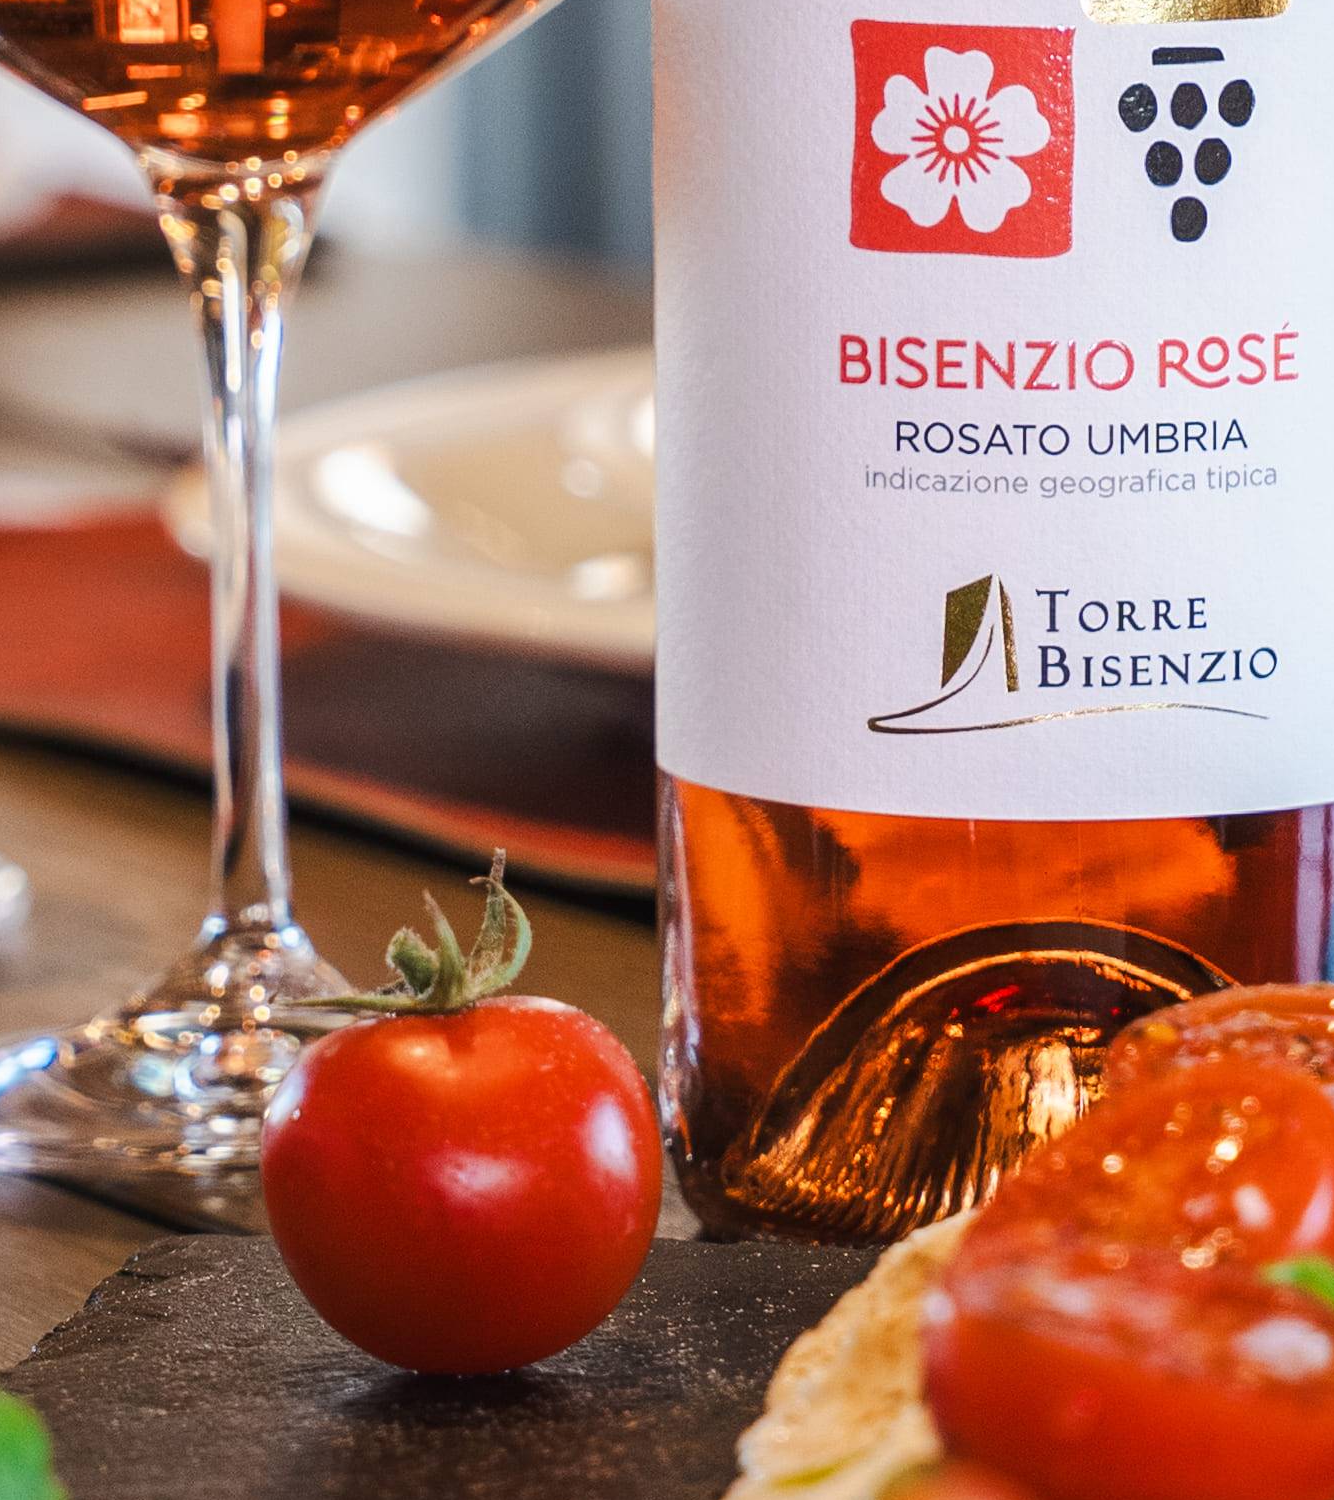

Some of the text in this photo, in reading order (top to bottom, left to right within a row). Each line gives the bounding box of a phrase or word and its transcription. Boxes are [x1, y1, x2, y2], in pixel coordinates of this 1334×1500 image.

[839, 322, 1299, 390] BISENZIO ROSÉ
[895, 419, 1248, 456] ROSATO UMBRIA
[865, 465, 1278, 498] indicazione geografica tipica
